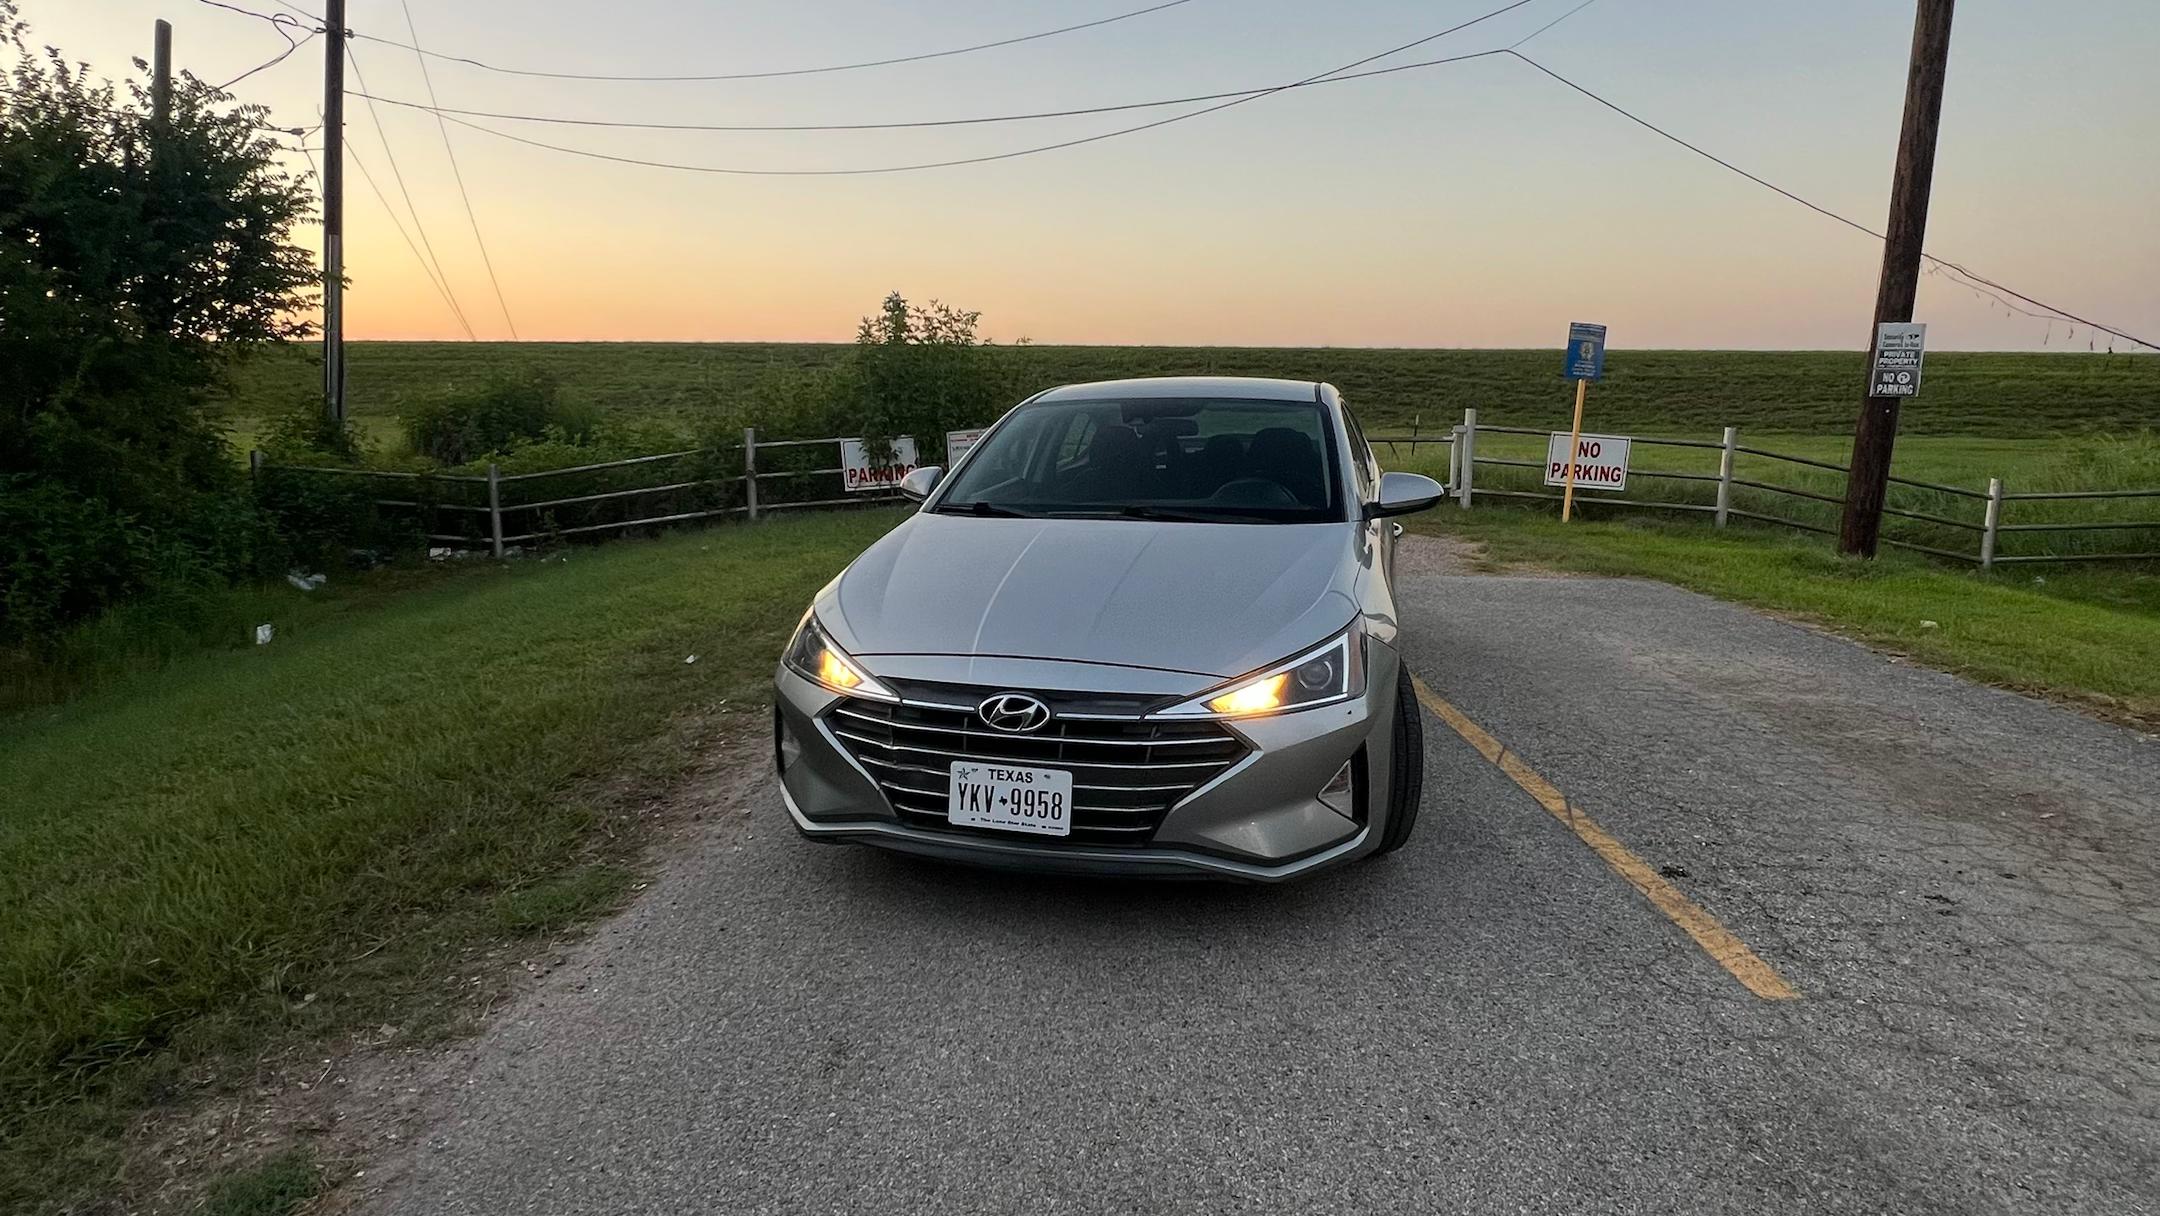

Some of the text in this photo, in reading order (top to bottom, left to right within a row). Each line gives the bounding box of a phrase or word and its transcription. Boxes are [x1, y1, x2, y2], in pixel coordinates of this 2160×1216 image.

[1883, 372, 1895, 383] NO
[1876, 384, 1914, 395] PARKING
[1578, 441, 1600, 458] NO
[1551, 462, 1622, 482] PARKING
[988, 768, 1033, 783] TEXAS
[958, 782, 1062, 820] YKV 9958
